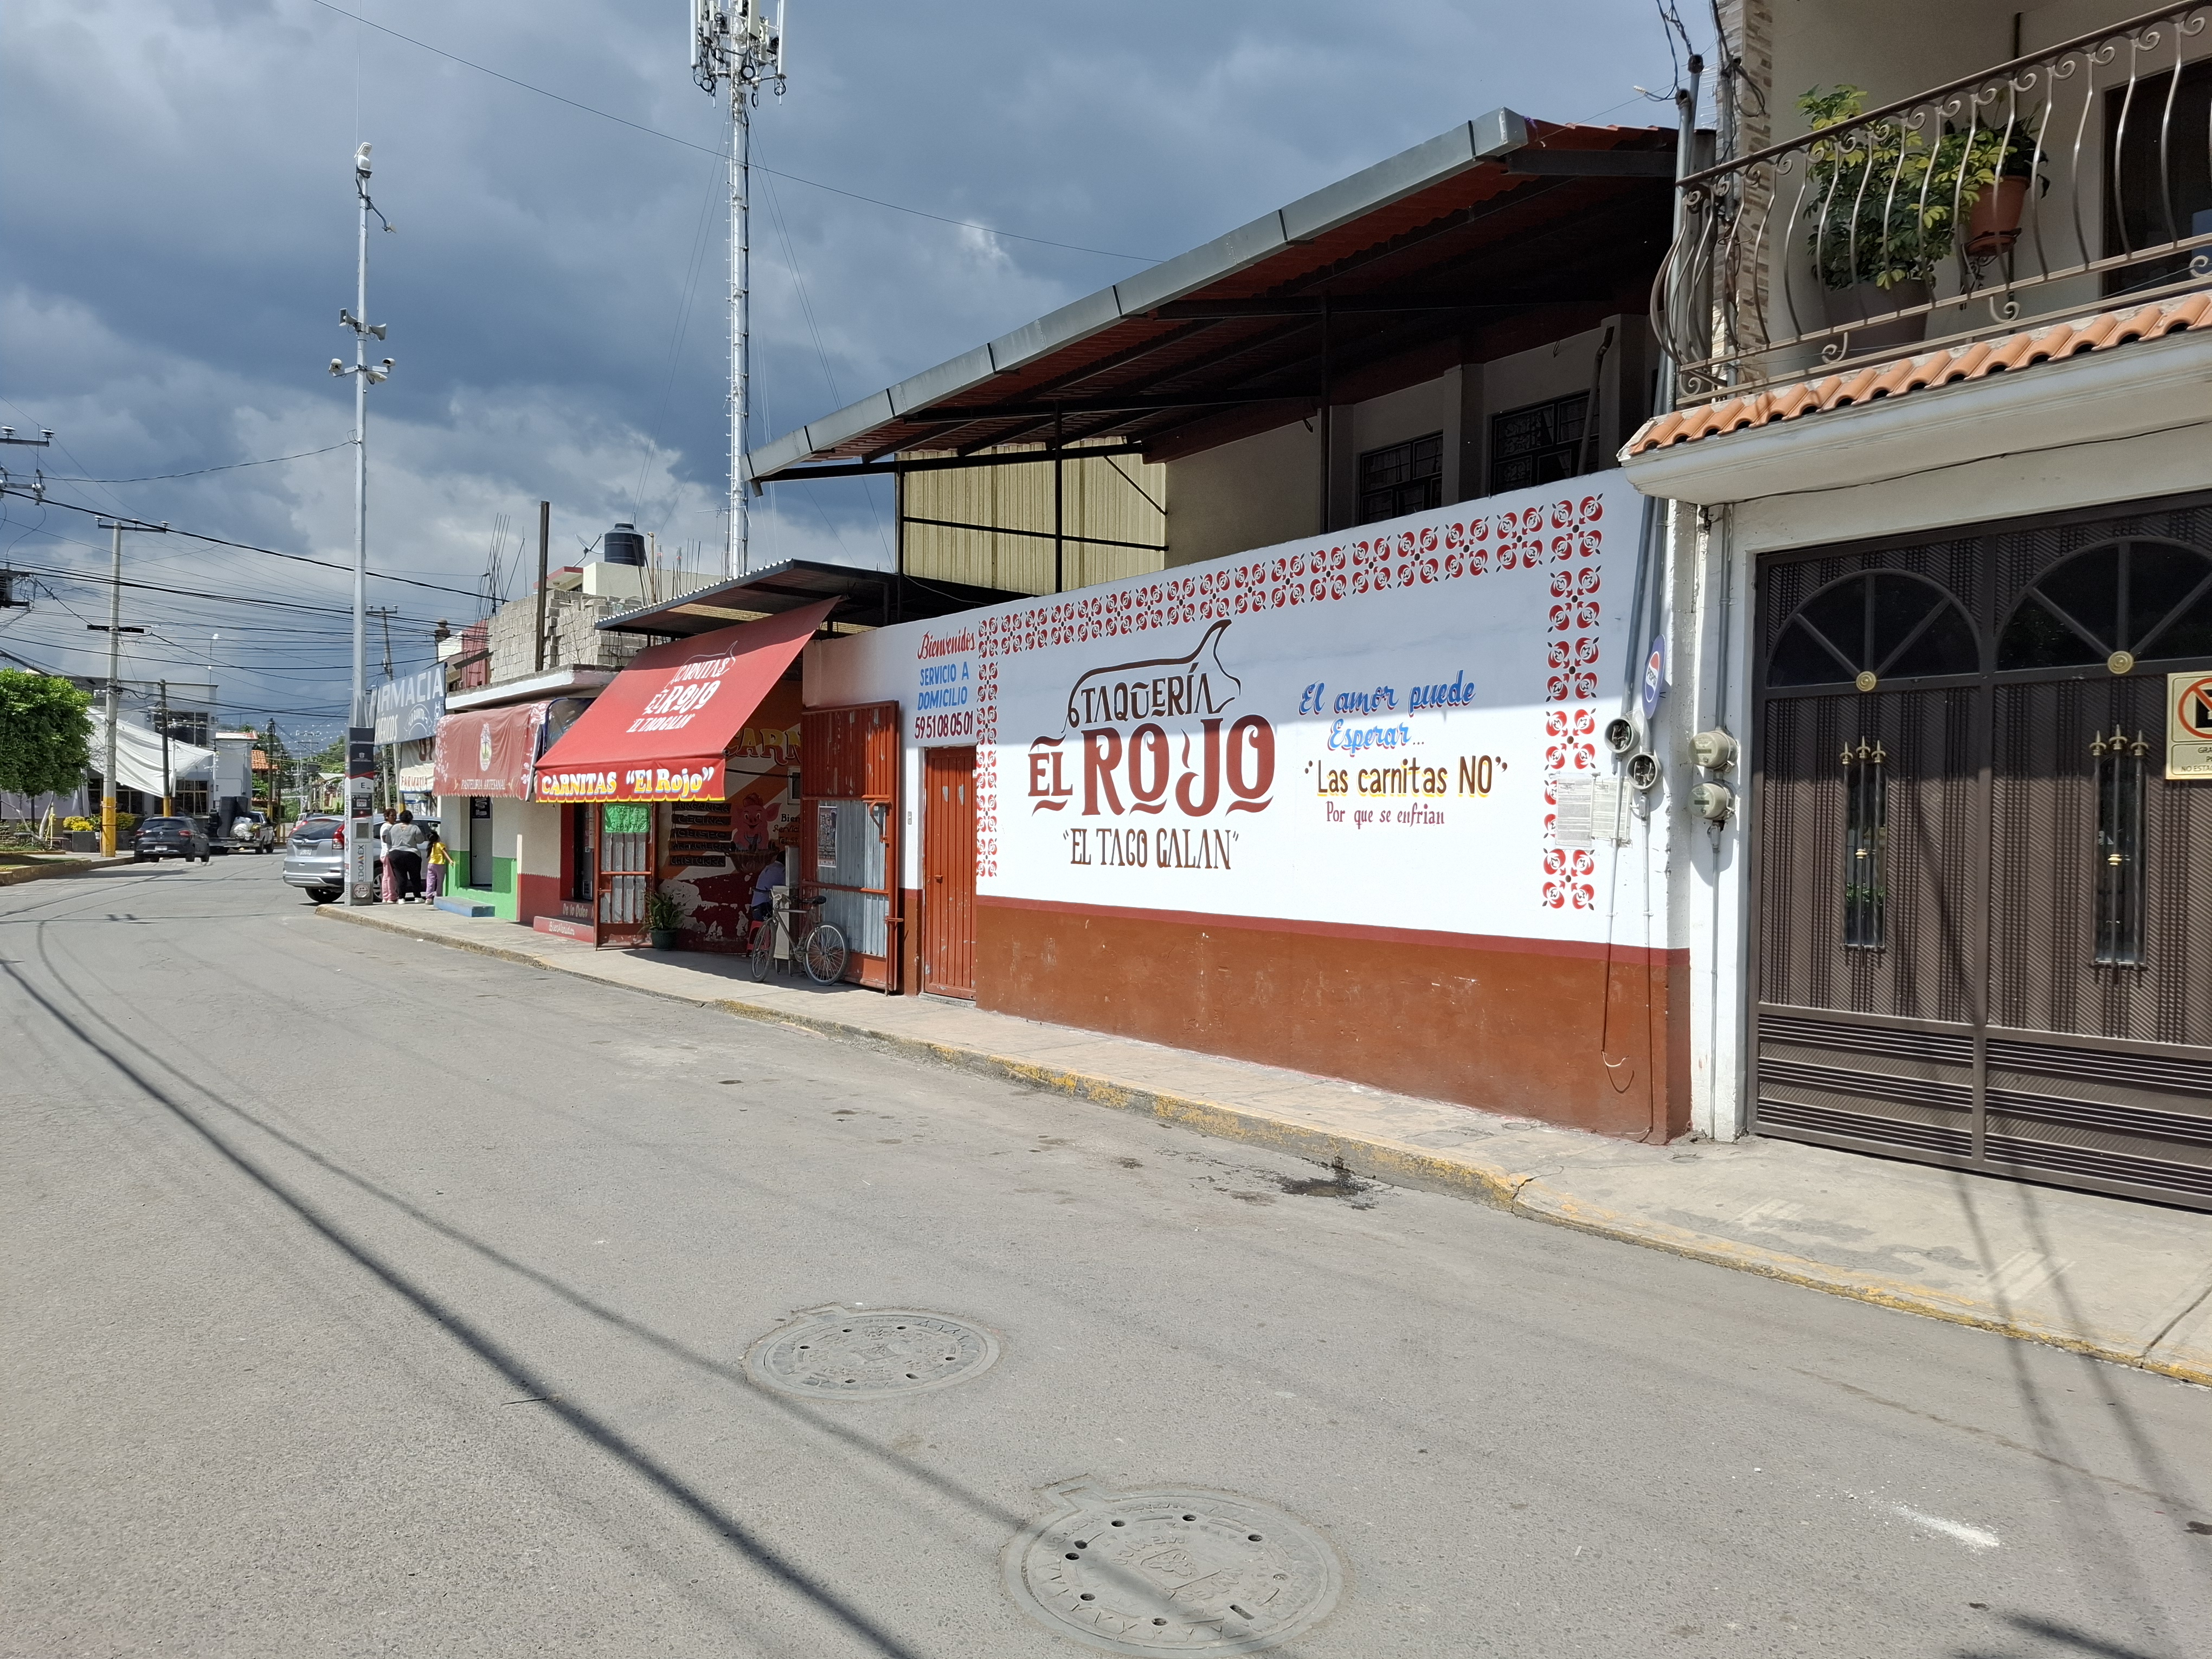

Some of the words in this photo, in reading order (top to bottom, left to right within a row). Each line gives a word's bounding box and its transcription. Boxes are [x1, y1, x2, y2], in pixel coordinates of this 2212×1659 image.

[917, 627, 976, 660] Bienvenidos
[673, 658, 730, 683] CARNITAS
[920, 664, 956, 686] SERVICIO
[961, 661, 969, 680] A
[1646, 667, 1657, 687] PEPSI
[654, 680, 721, 714] ROJO
[917, 686, 968, 711] DOMICILIO
[1081, 662, 1214, 724] TAQUERÍA
[1299, 680, 1325, 715] El
[1334, 685, 1399, 715] amor
[1409, 670, 1476, 718] puede
[374, 713, 398, 744] ENÉRICOS
[1028, 748, 1073, 798] EL
[1081, 715, 1275, 817] ROJO
[1357, 757, 1448, 797] carnitas
[401, 776, 427, 787] FARMACIA
[542, 771, 617, 796] CARNITAS
[678, 816, 723, 825] CECINA
[1326, 801, 1345, 821] Por
[1354, 809, 1373, 829] que
[1379, 811, 1391, 822] se
[1397, 802, 1444, 827] enfrian
[678, 829, 725, 839] OBISPO
[1096, 828, 1148, 867] TACO
